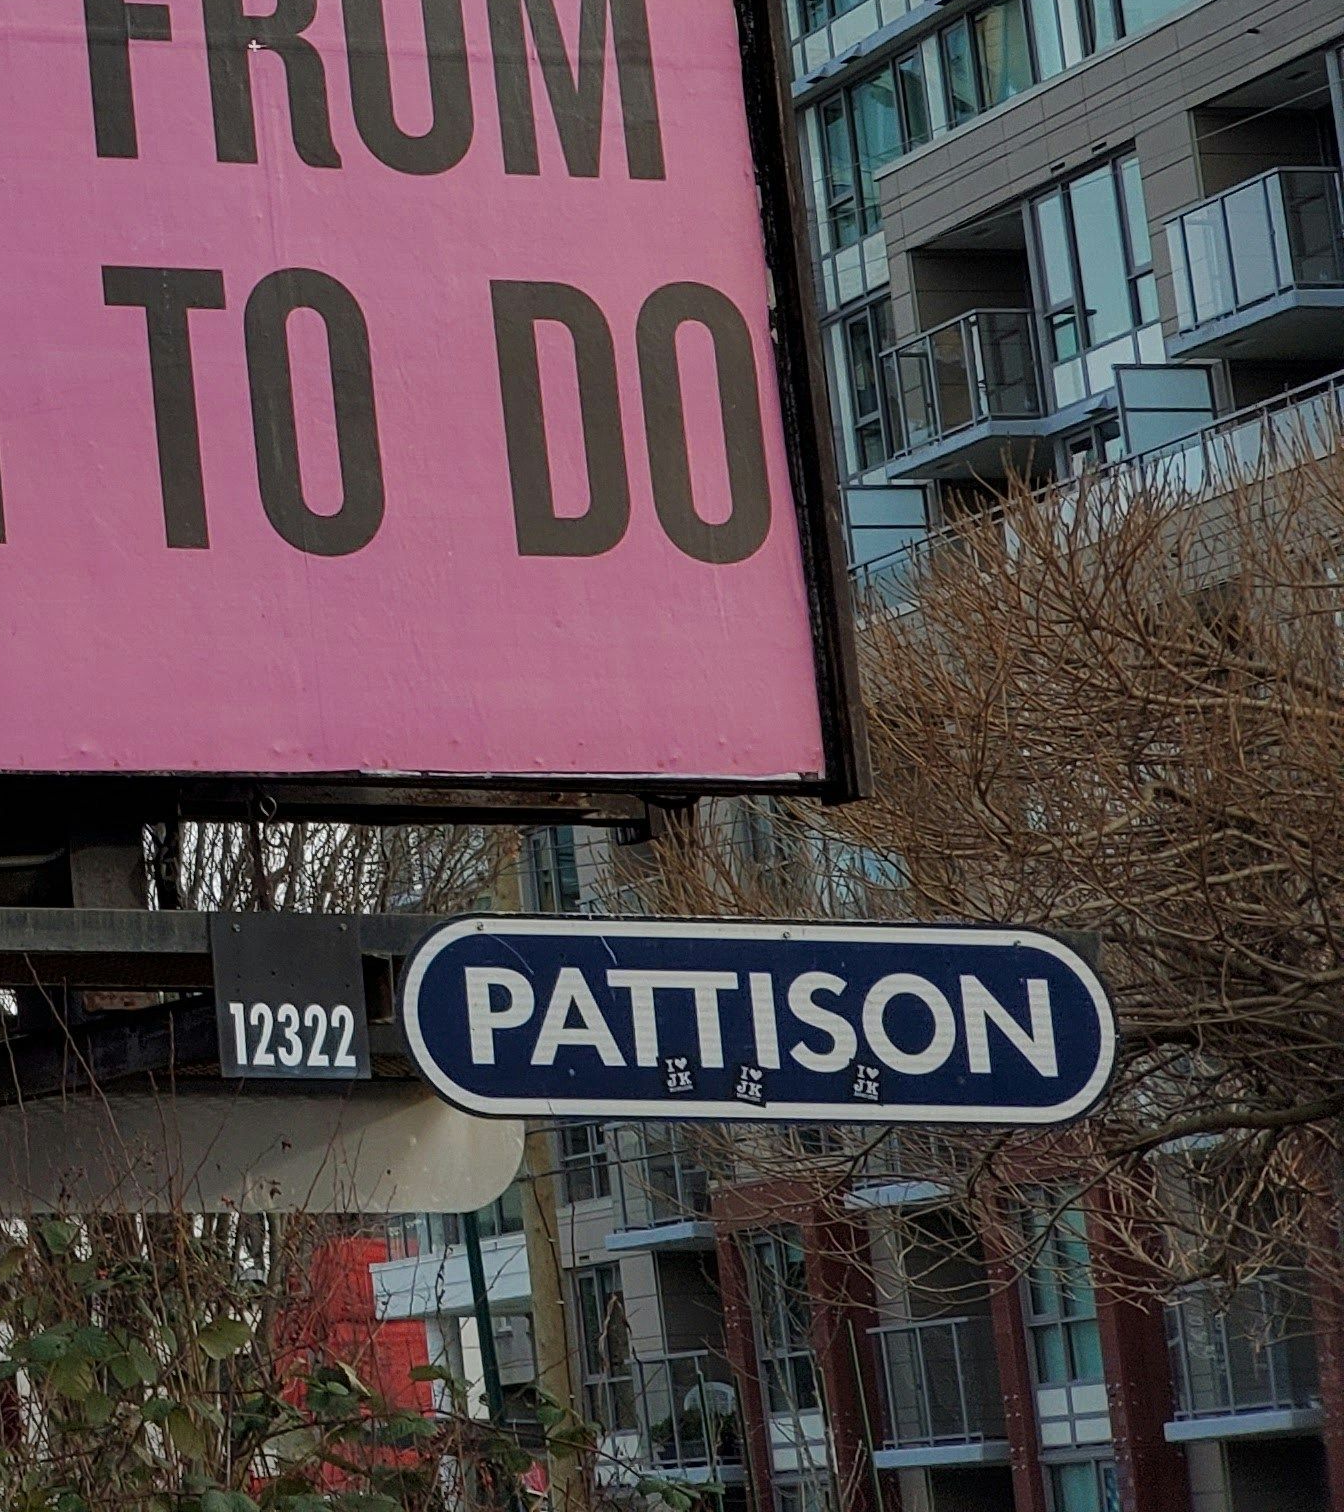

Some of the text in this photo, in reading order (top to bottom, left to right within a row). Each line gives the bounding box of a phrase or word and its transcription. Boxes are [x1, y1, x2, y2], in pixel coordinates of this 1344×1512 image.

[101, 265, 385, 557] TO
[489, 280, 771, 564] DO
[229, 1002, 357, 1067] 12322
[465, 967, 1058, 1076] PATTISON
[667, 1071, 692, 1087] JK
[736, 1081, 762, 1097] JK
[853, 1079, 879, 1096] JK
